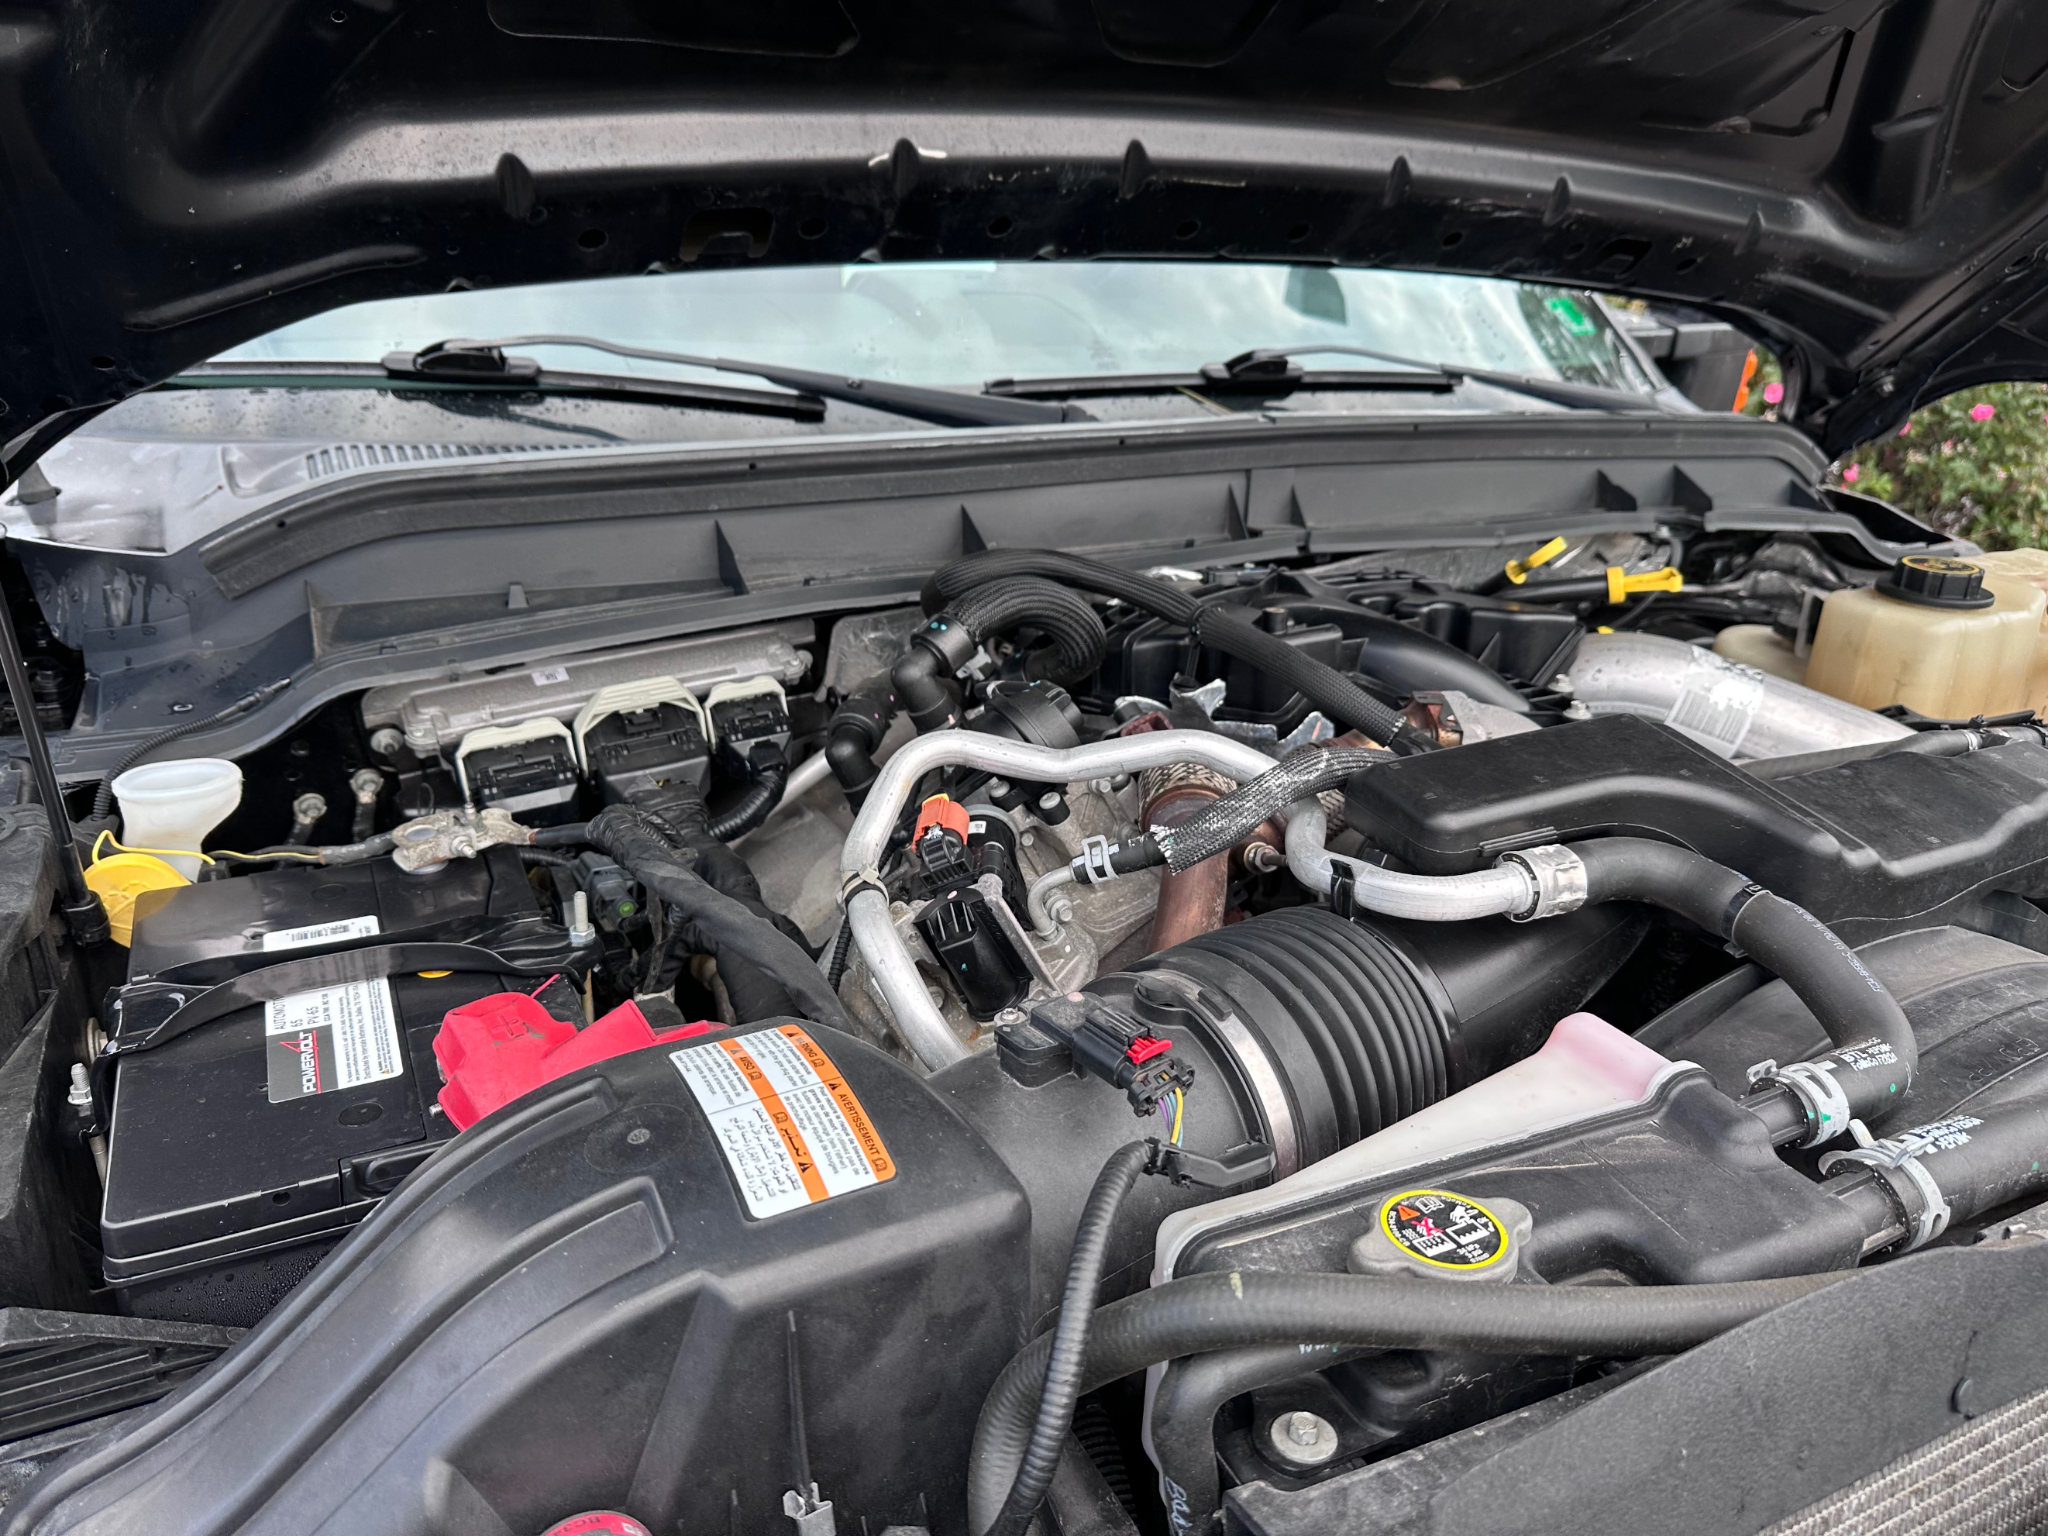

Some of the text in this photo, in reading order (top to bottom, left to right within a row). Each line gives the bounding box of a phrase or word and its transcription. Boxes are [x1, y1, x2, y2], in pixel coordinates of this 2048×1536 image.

[290, 1019, 304, 1027] 65
[298, 1028, 316, 1093] POWERVOLT
[738, 1054, 756, 1071] AVISO
[836, 1092, 881, 1157] AVERTISSEMENT
[850, 1144, 872, 1175] blessures
[1477, 1216, 1490, 1224] OK
